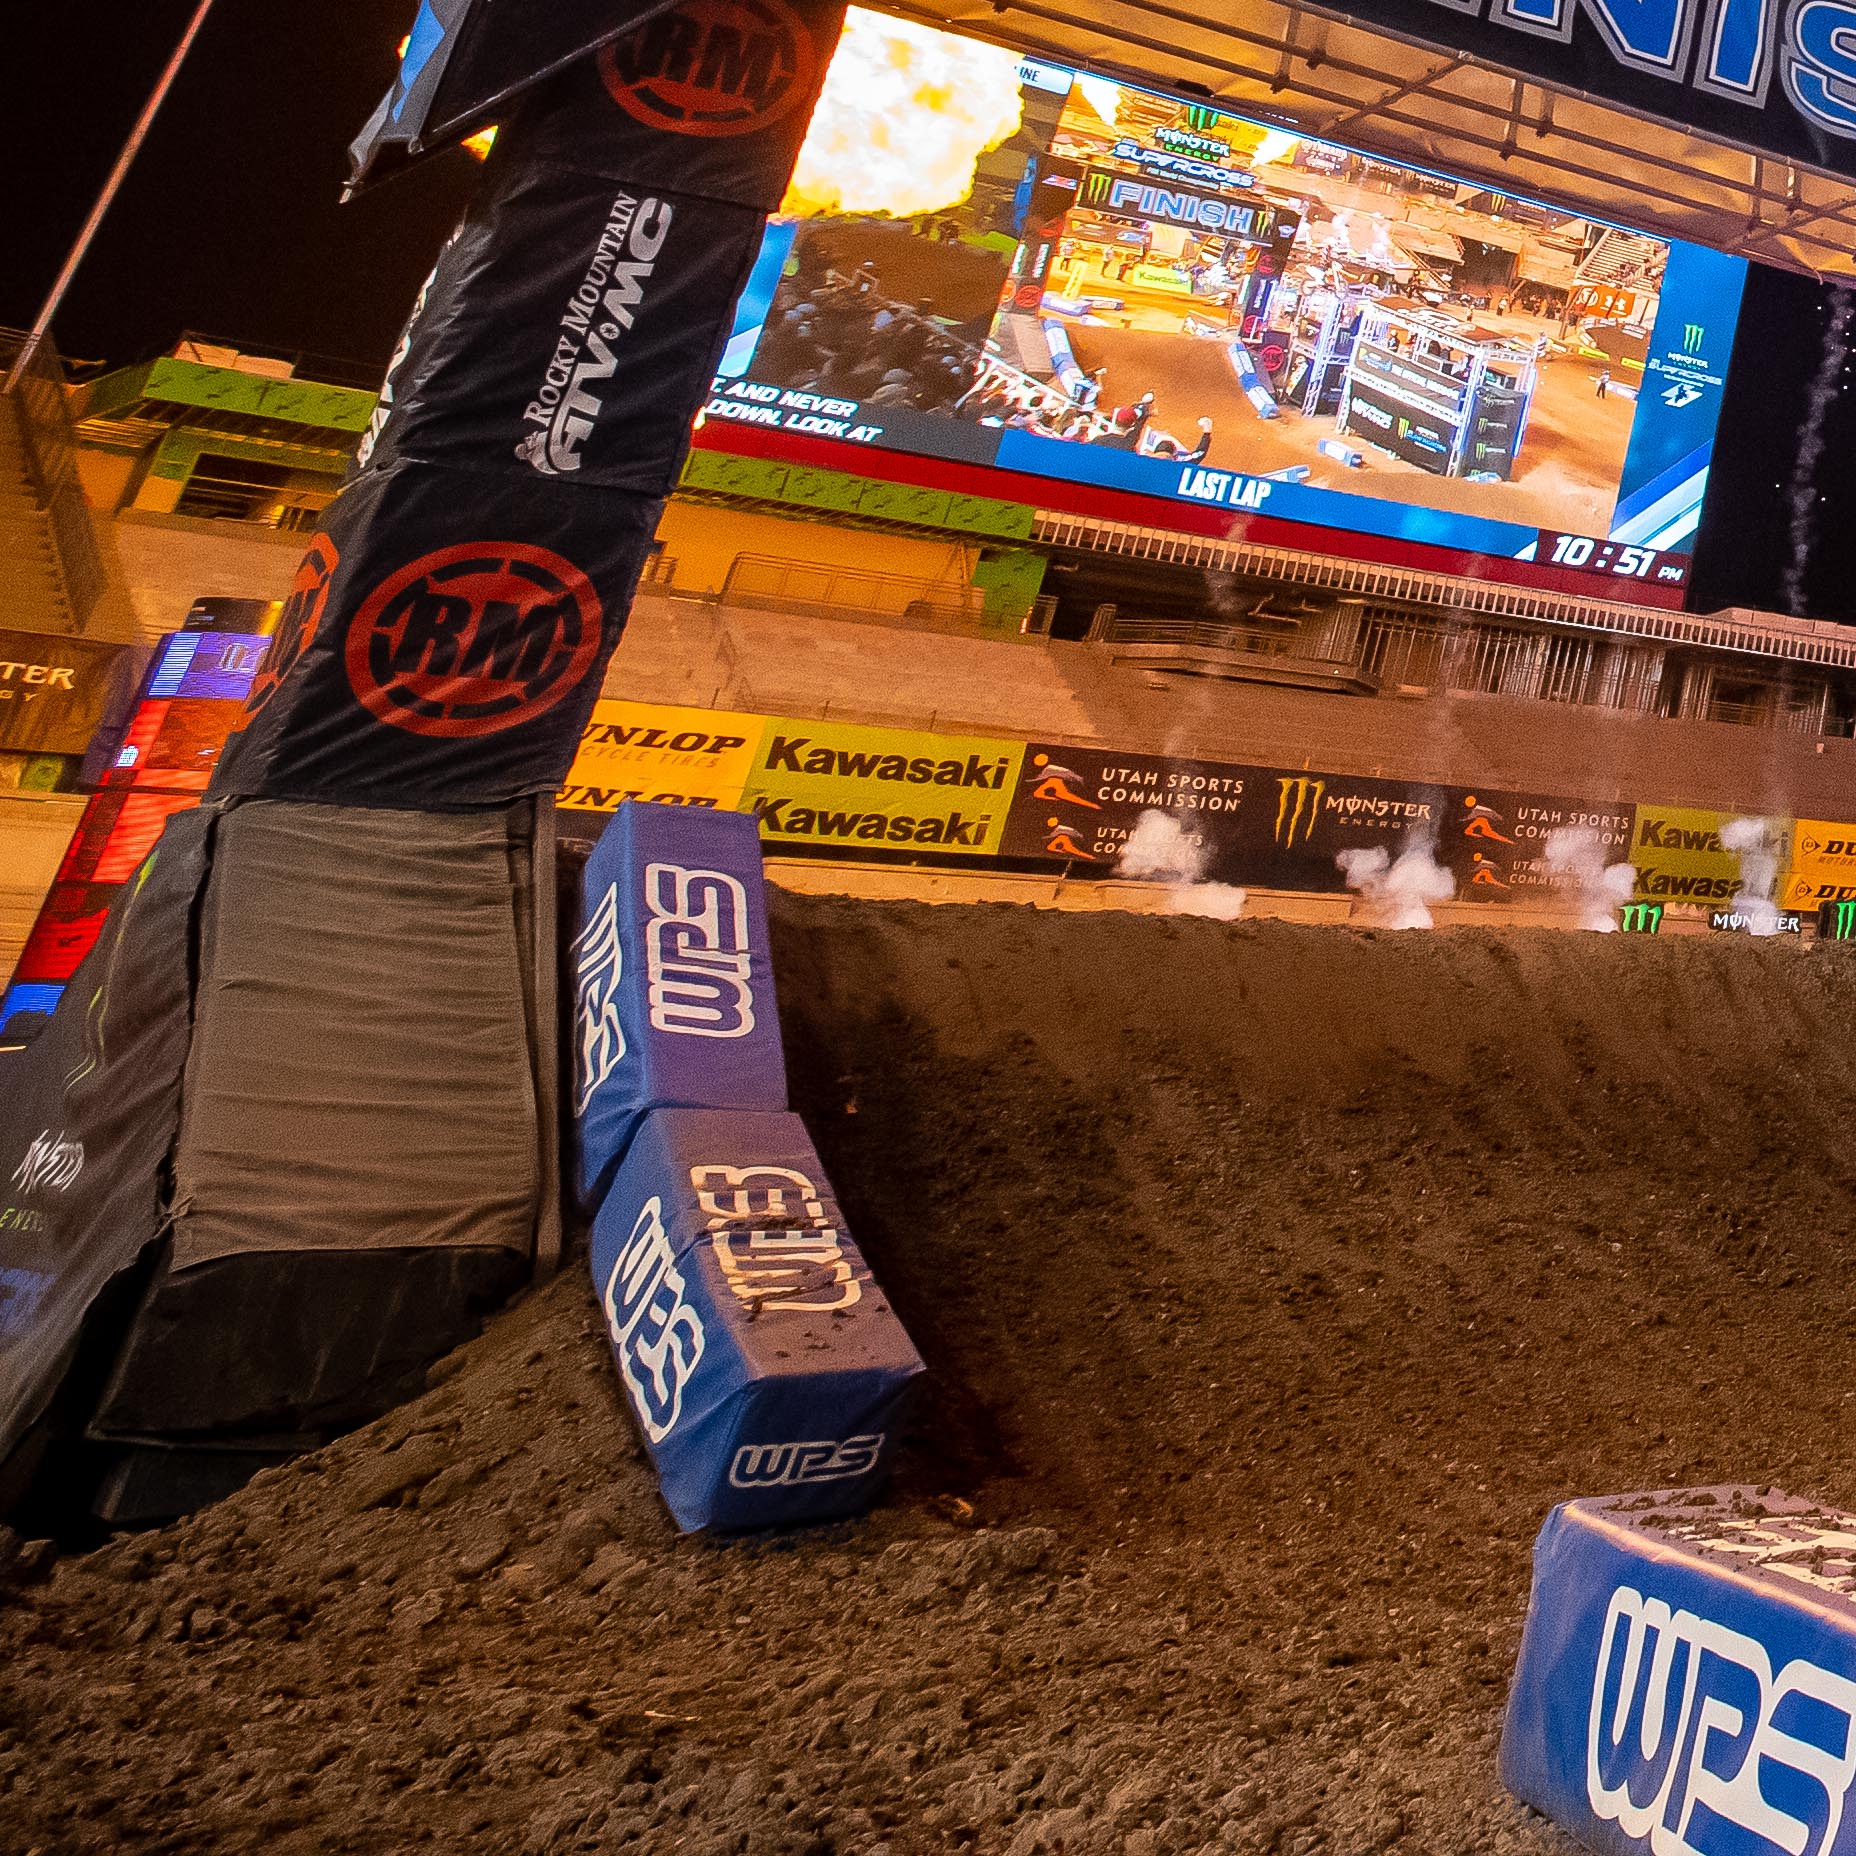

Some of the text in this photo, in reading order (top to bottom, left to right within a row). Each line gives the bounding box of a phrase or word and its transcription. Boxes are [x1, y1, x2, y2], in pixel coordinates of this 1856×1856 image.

[1108, 178, 1257, 235] FINISH
[560, 189, 639, 335] MOUNTAIN
[724, 381, 780, 403] AND
[777, 390, 859, 418] NEVER
[784, 413, 851, 439] LOOK
[847, 425, 883, 442] AT
[1177, 467, 1272, 508] LAST LAP
[1658, 565, 1684, 581] PM
[763, 735, 1010, 791] Kawasaki
[1102, 767, 1245, 795] UTAH SPORTS
[1097, 786, 1241, 813] COMMISSION
[1326, 795, 1432, 821] MONSTER
[757, 796, 991, 846] Kawasaki
[1517, 808, 1630, 830] UTAH SPORTS
[729, 1434, 885, 1489] WPS
